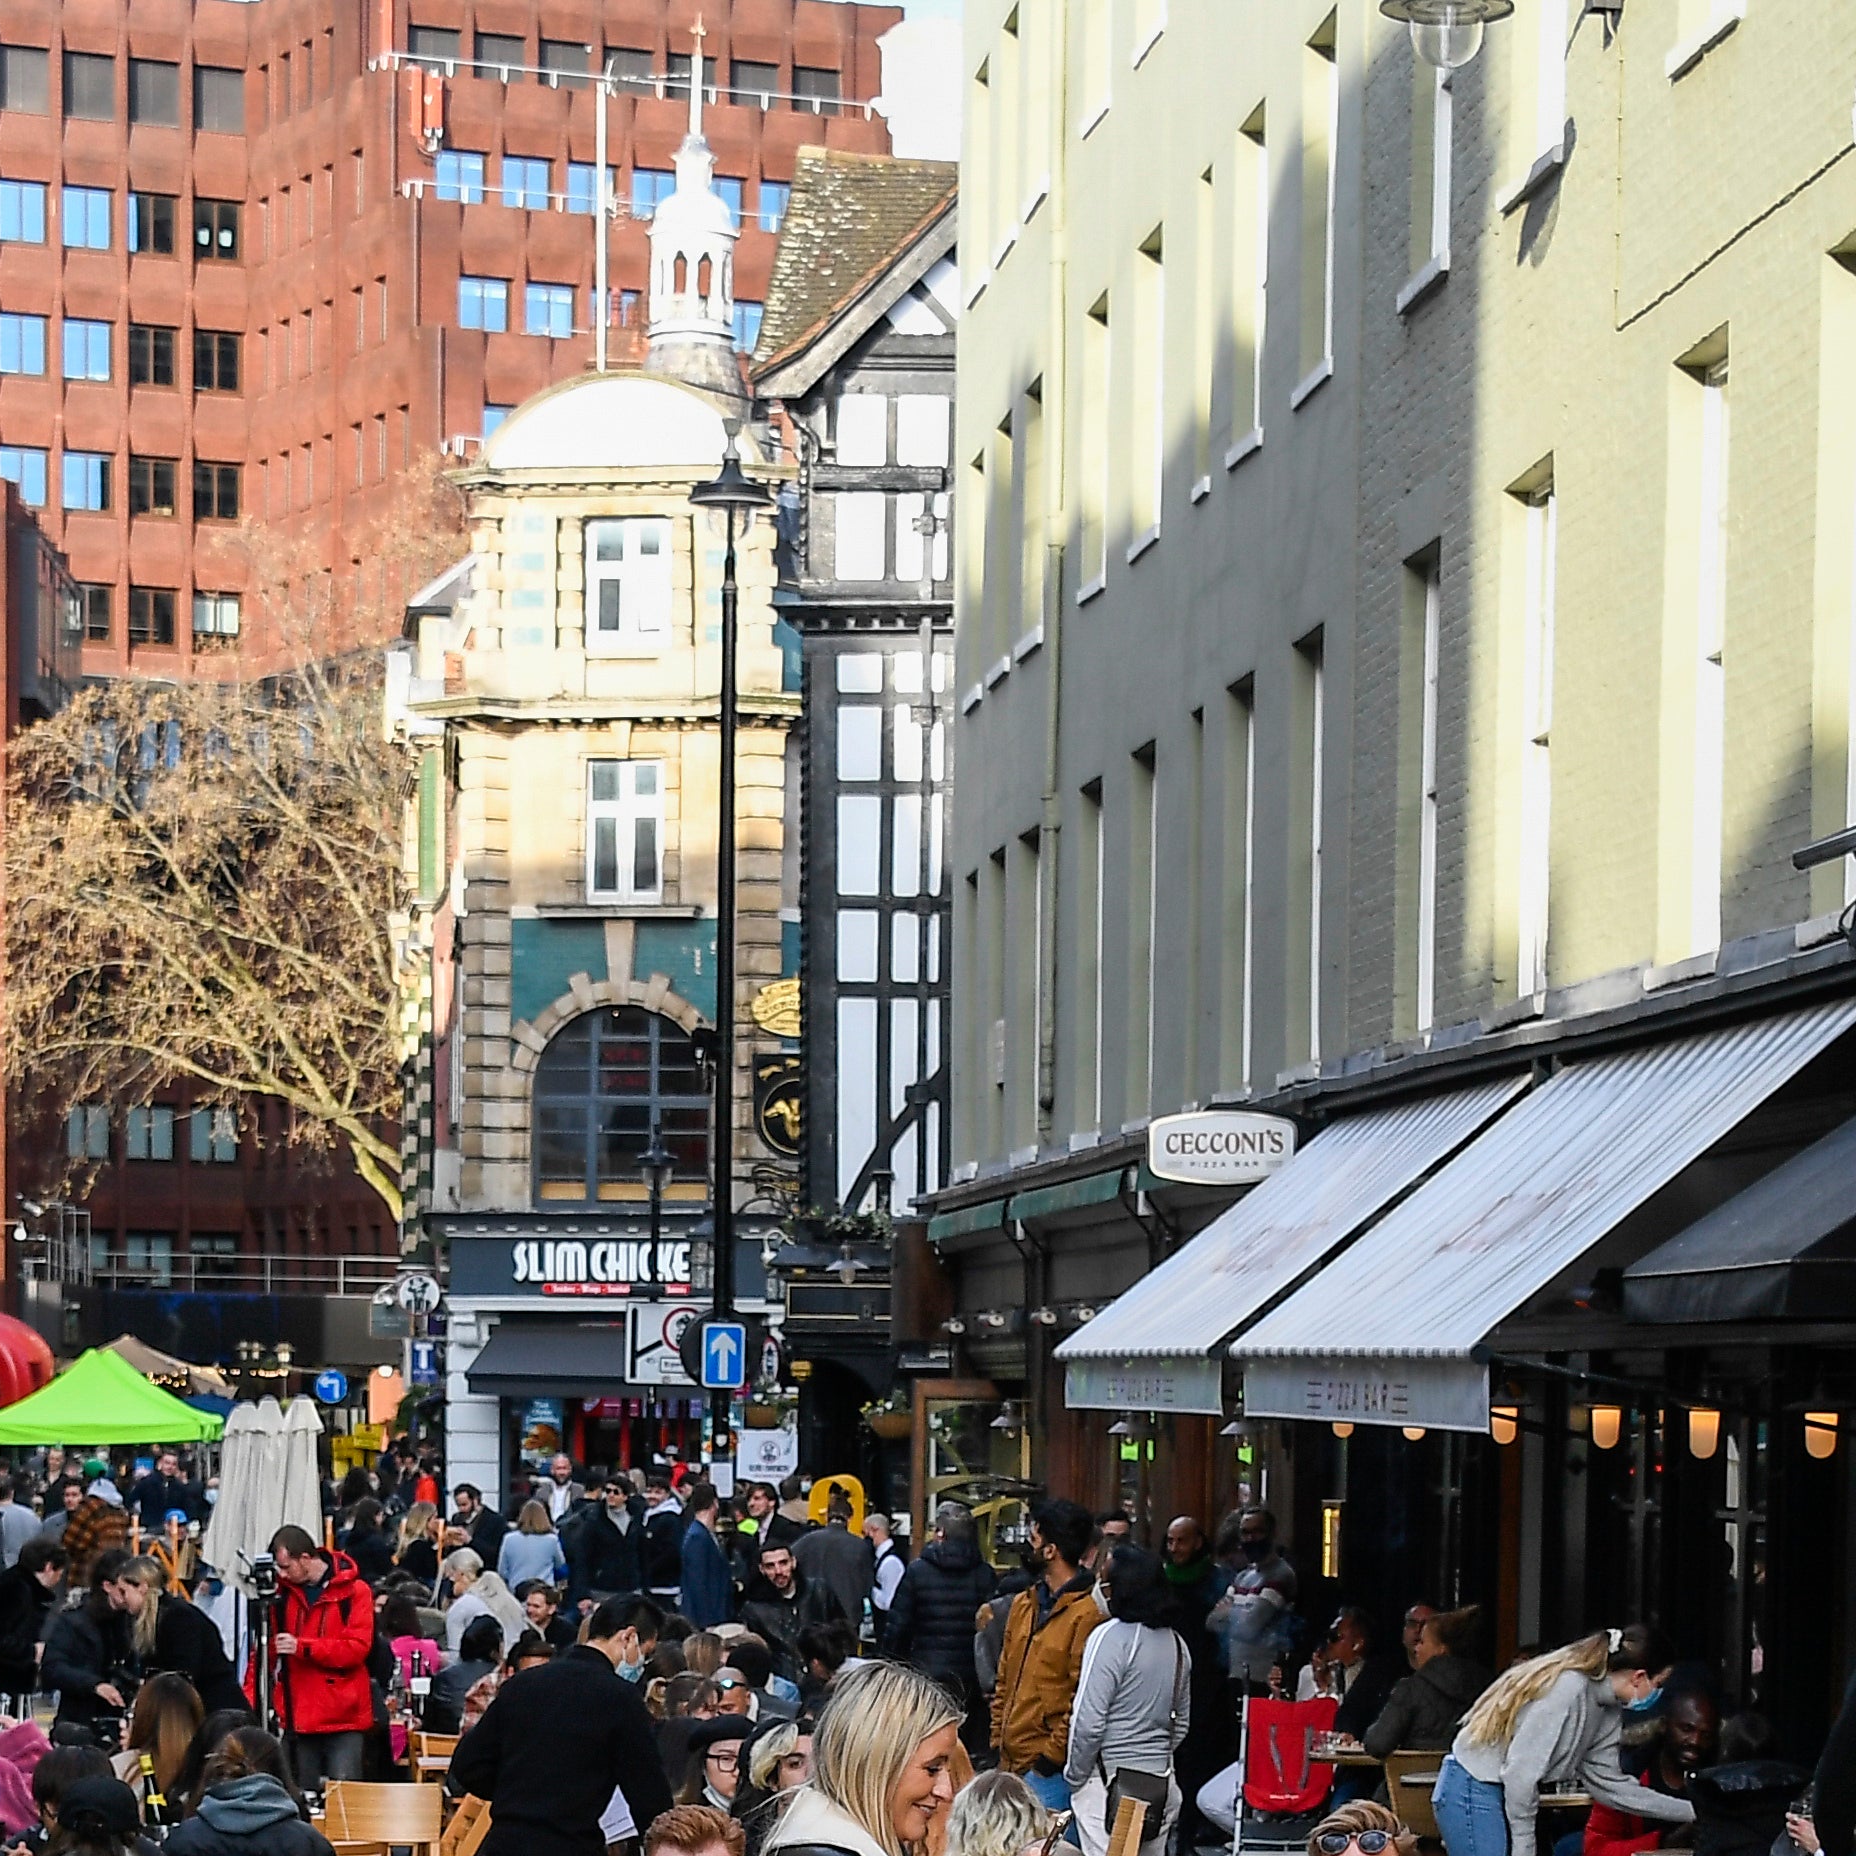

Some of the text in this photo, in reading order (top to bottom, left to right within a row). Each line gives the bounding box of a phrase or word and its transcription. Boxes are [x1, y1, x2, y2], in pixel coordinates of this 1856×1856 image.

[1165, 1129, 1284, 1155] CECCONI'S
[512, 1240, 691, 1283] SLIM CHICKE
